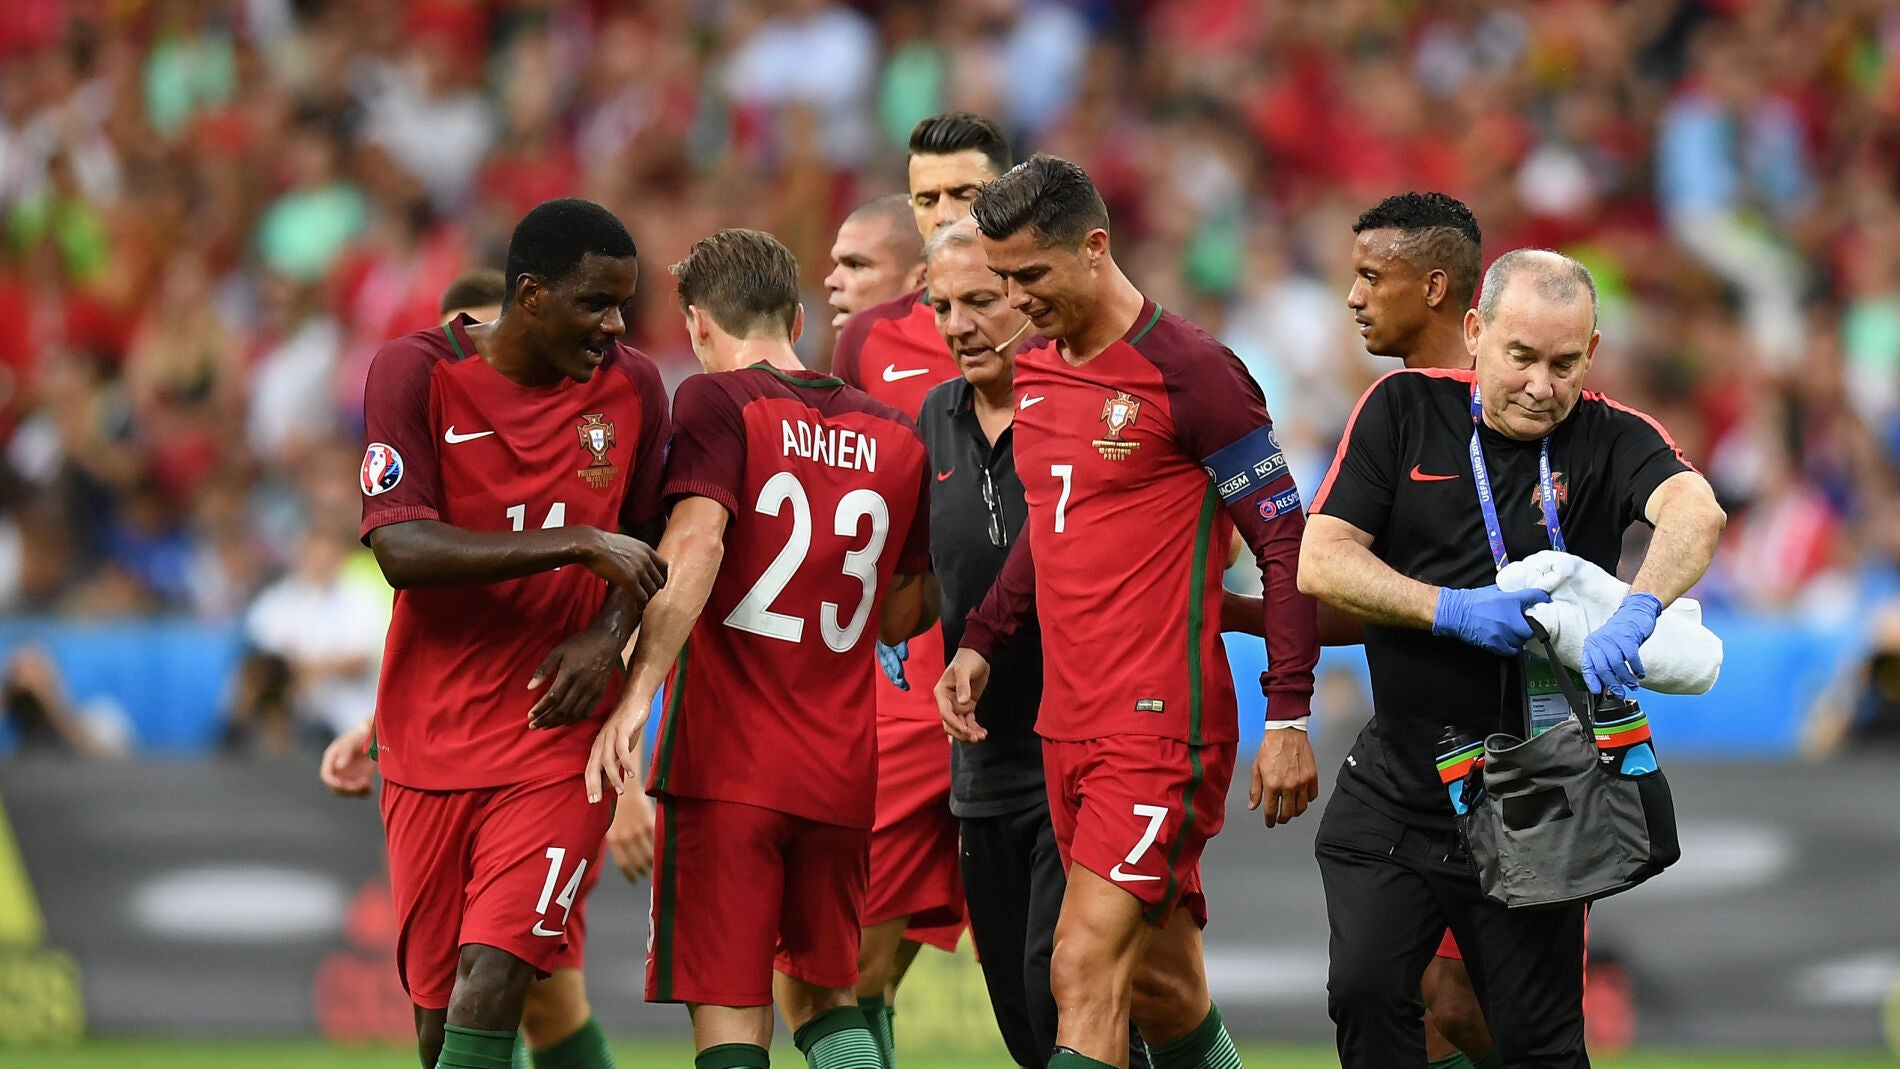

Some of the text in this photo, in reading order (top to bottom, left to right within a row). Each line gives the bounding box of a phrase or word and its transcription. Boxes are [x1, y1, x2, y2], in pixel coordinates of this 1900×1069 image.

[781, 419, 877, 473] ADRIEN
[1254, 455, 1284, 477] NO TO
[1475, 456, 1485, 479] EURO
[1050, 464, 1073, 533] 7
[1480, 479, 1490, 502] UEFA
[1543, 479, 1551, 502] UEFA
[722, 471, 890, 653] 23
[1124, 803, 1169, 865] 7
[535, 847, 588, 926] 14
